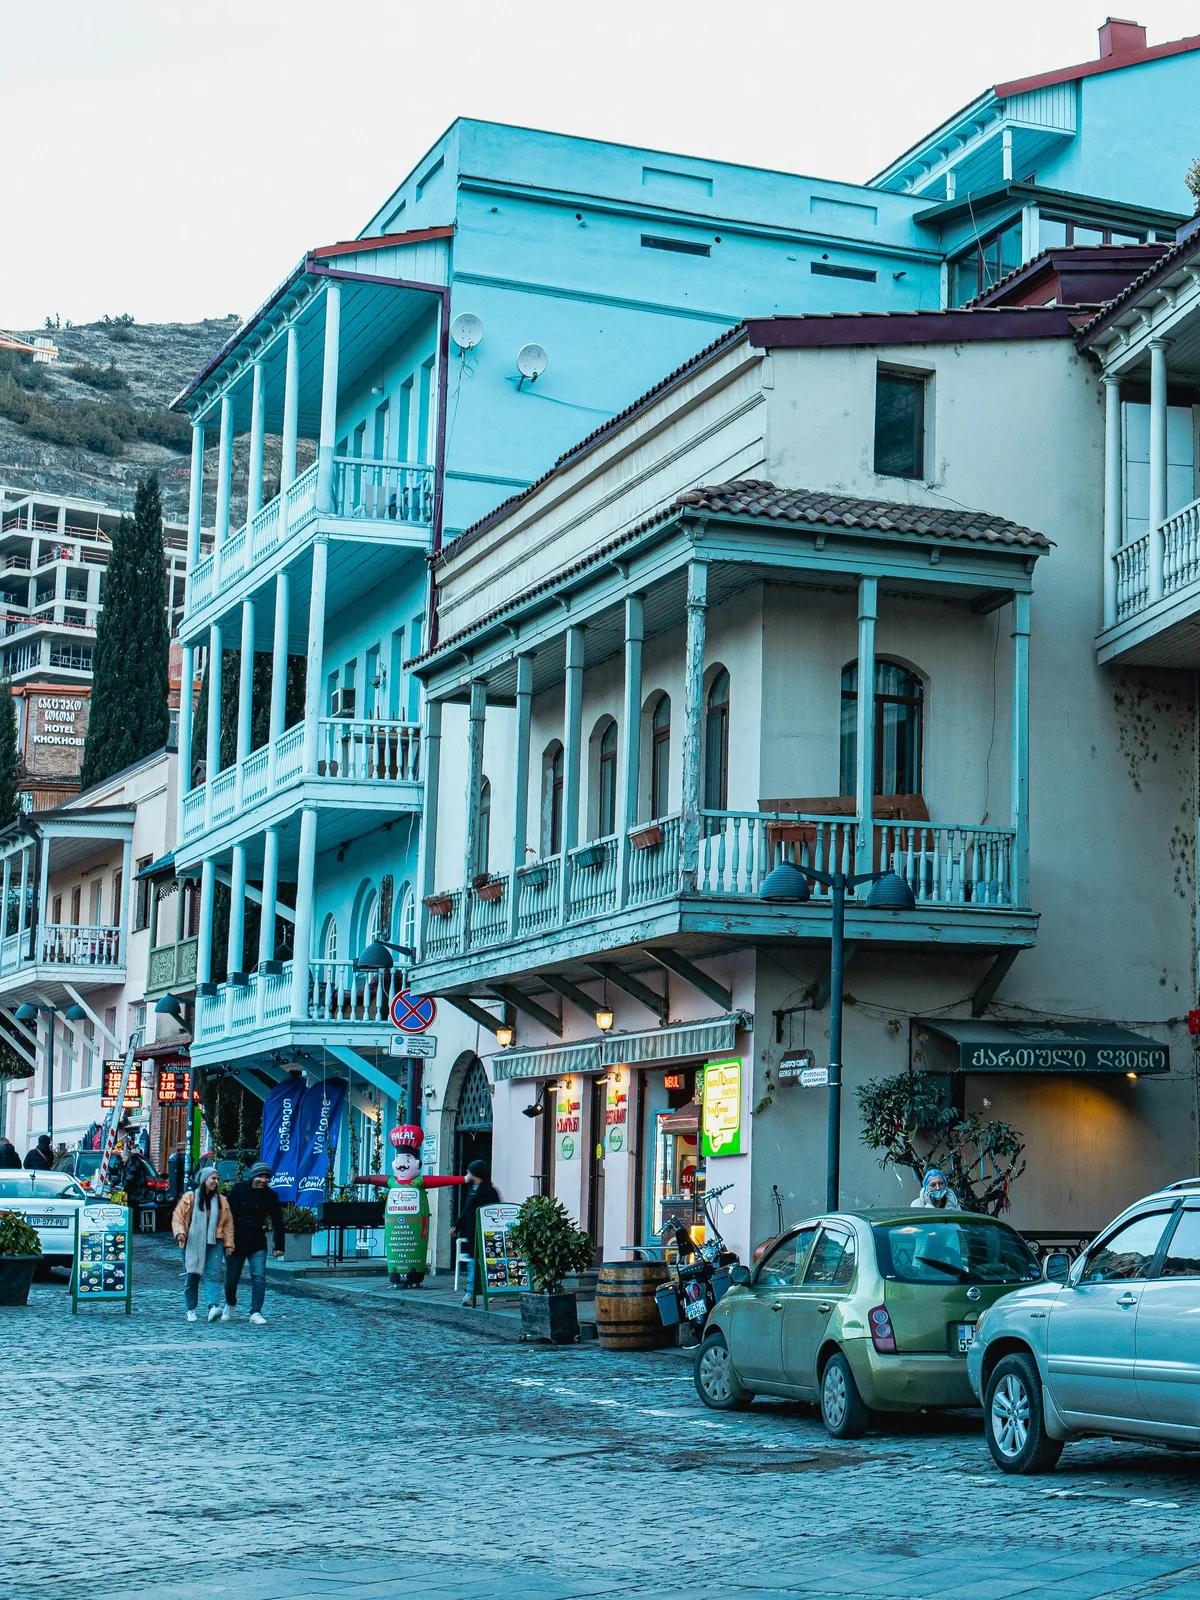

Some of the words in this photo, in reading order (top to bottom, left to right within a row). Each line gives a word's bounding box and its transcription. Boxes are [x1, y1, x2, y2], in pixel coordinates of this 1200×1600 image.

[44, 724, 75, 734] HOTEL
[33, 734, 85, 746] KHOKHOBI
[972, 1049, 1086, 1067] ქართული
[1097, 1049, 1166, 1067] ღვინო
[313, 1099, 331, 1155] Welcome
[390, 1131, 415, 1139] HALAL
